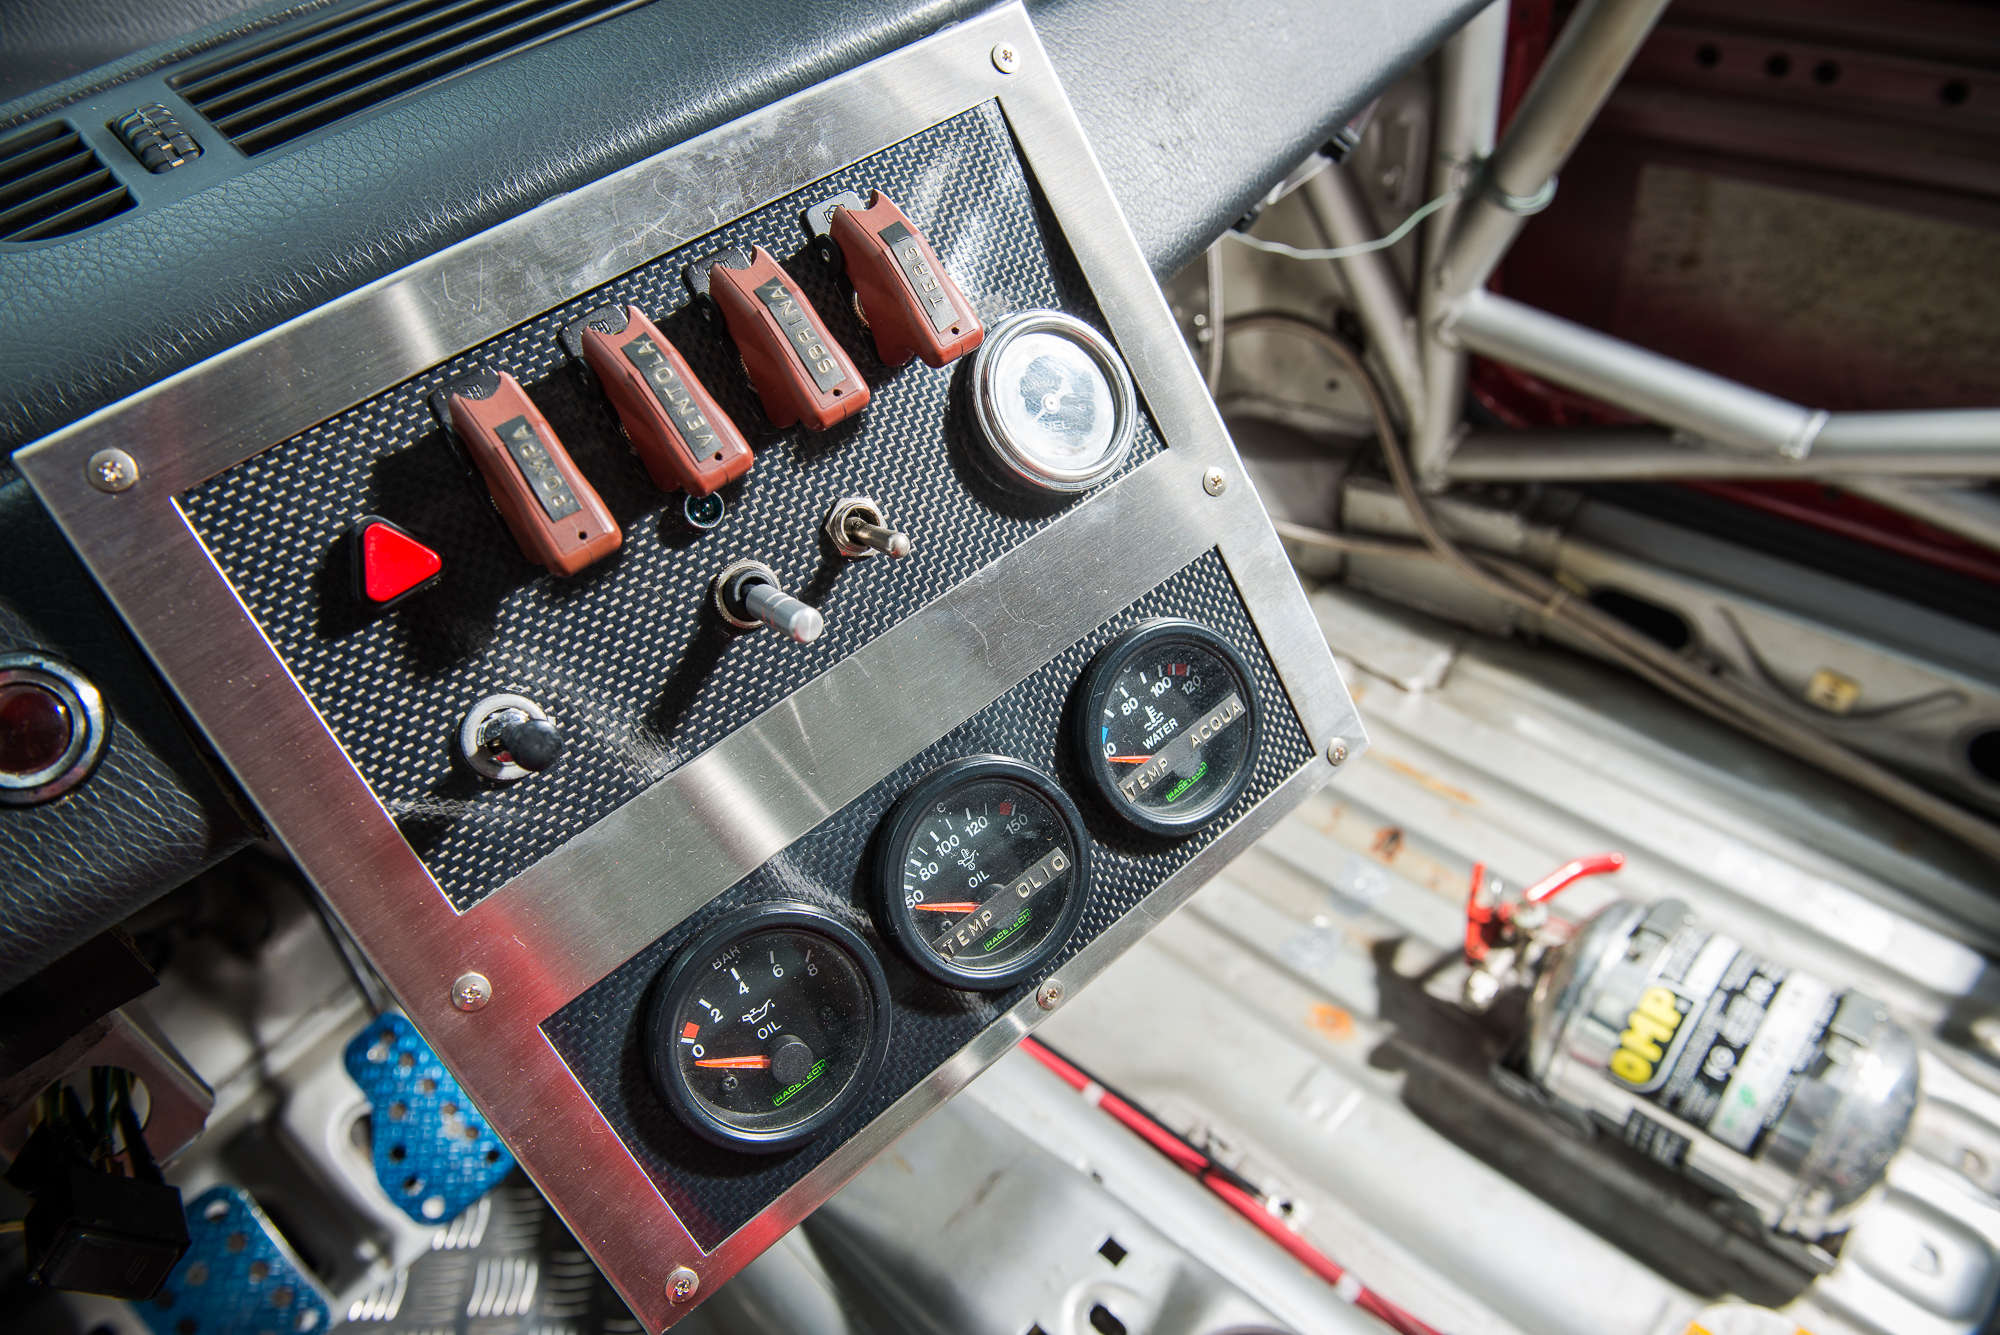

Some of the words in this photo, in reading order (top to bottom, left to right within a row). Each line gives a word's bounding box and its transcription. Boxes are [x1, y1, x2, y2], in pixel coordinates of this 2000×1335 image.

[896, 236, 945, 309] TERGI
[770, 285, 836, 374] SBRINA
[637, 340, 714, 449] VENTOLA
[511, 424, 571, 507] POMPA
[1150, 676, 1172, 698] 100
[1181, 675, 1201, 696] 120
[1121, 697, 1139, 717] 80
[1143, 718, 1179, 750] WATER
[1128, 758, 1169, 798] TEMP
[1189, 703, 1243, 749] ACQUA
[965, 815, 988, 838] 120
[1005, 814, 1028, 835] 150
[935, 834, 960, 857] 100
[919, 862, 939, 881] 80
[968, 870, 990, 888] OIL
[942, 910, 994, 954] TEMP
[1015, 855, 1066, 899] OLIO
[712, 946, 741, 970] BAR
[772, 963, 784, 978] 6
[808, 963, 819, 976] 8
[738, 981, 750, 995] 4
[710, 1008, 724, 1023] 2
[757, 1021, 782, 1040] OIL
[1611, 986, 1684, 1084] OMP
[692, 1044, 705, 1058] 0
